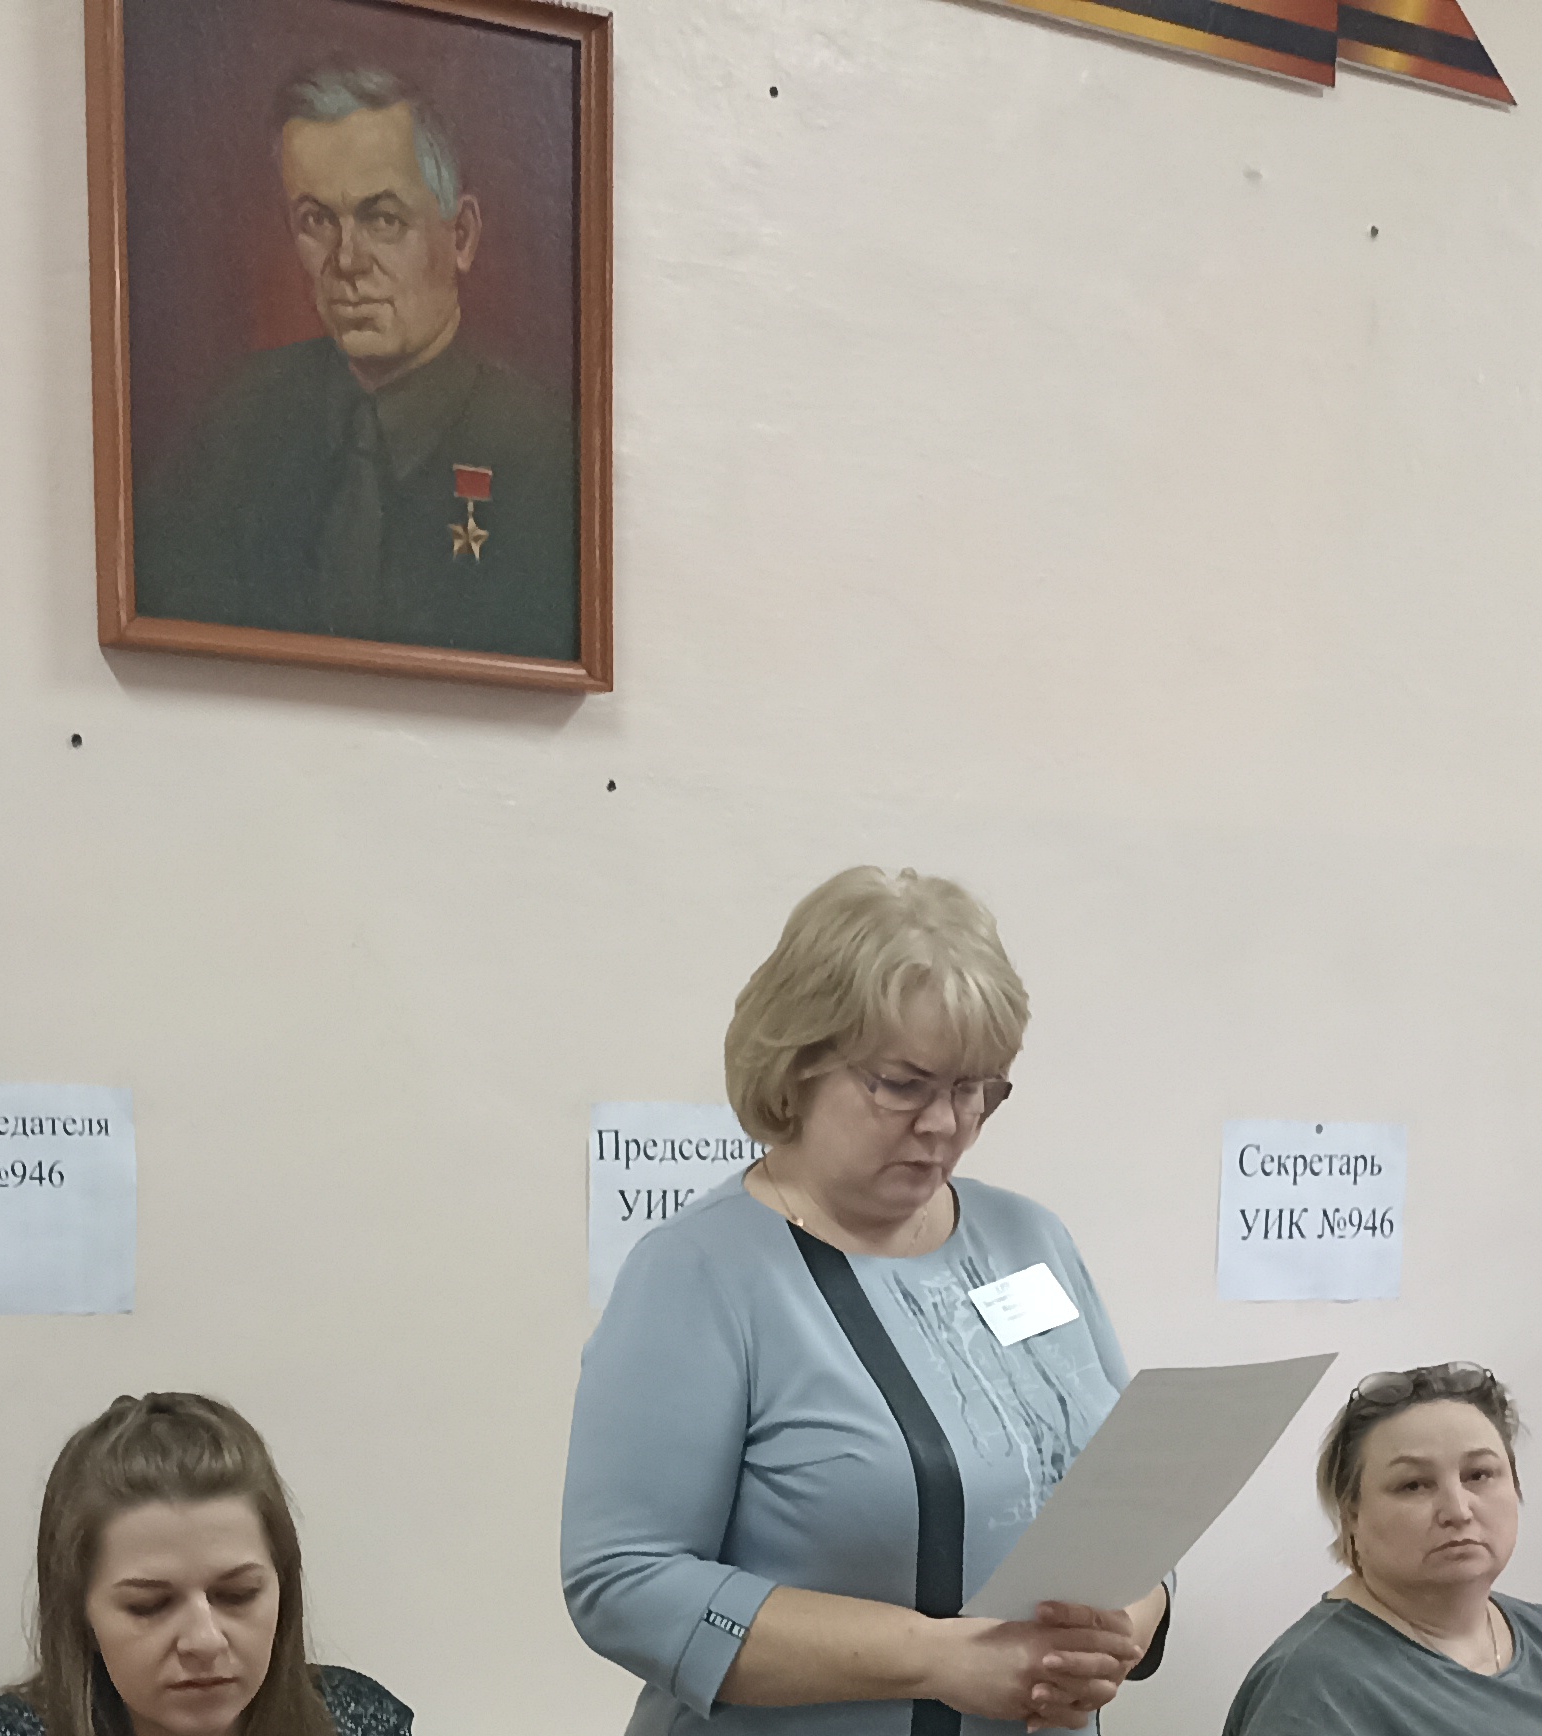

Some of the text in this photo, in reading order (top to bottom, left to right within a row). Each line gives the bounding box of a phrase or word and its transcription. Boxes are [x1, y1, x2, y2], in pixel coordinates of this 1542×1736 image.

[1239, 1143, 1383, 1186] Секретарь
[618, 1188, 695, 1222] УИК
[1239, 1206, 1395, 1241] УИК №946
